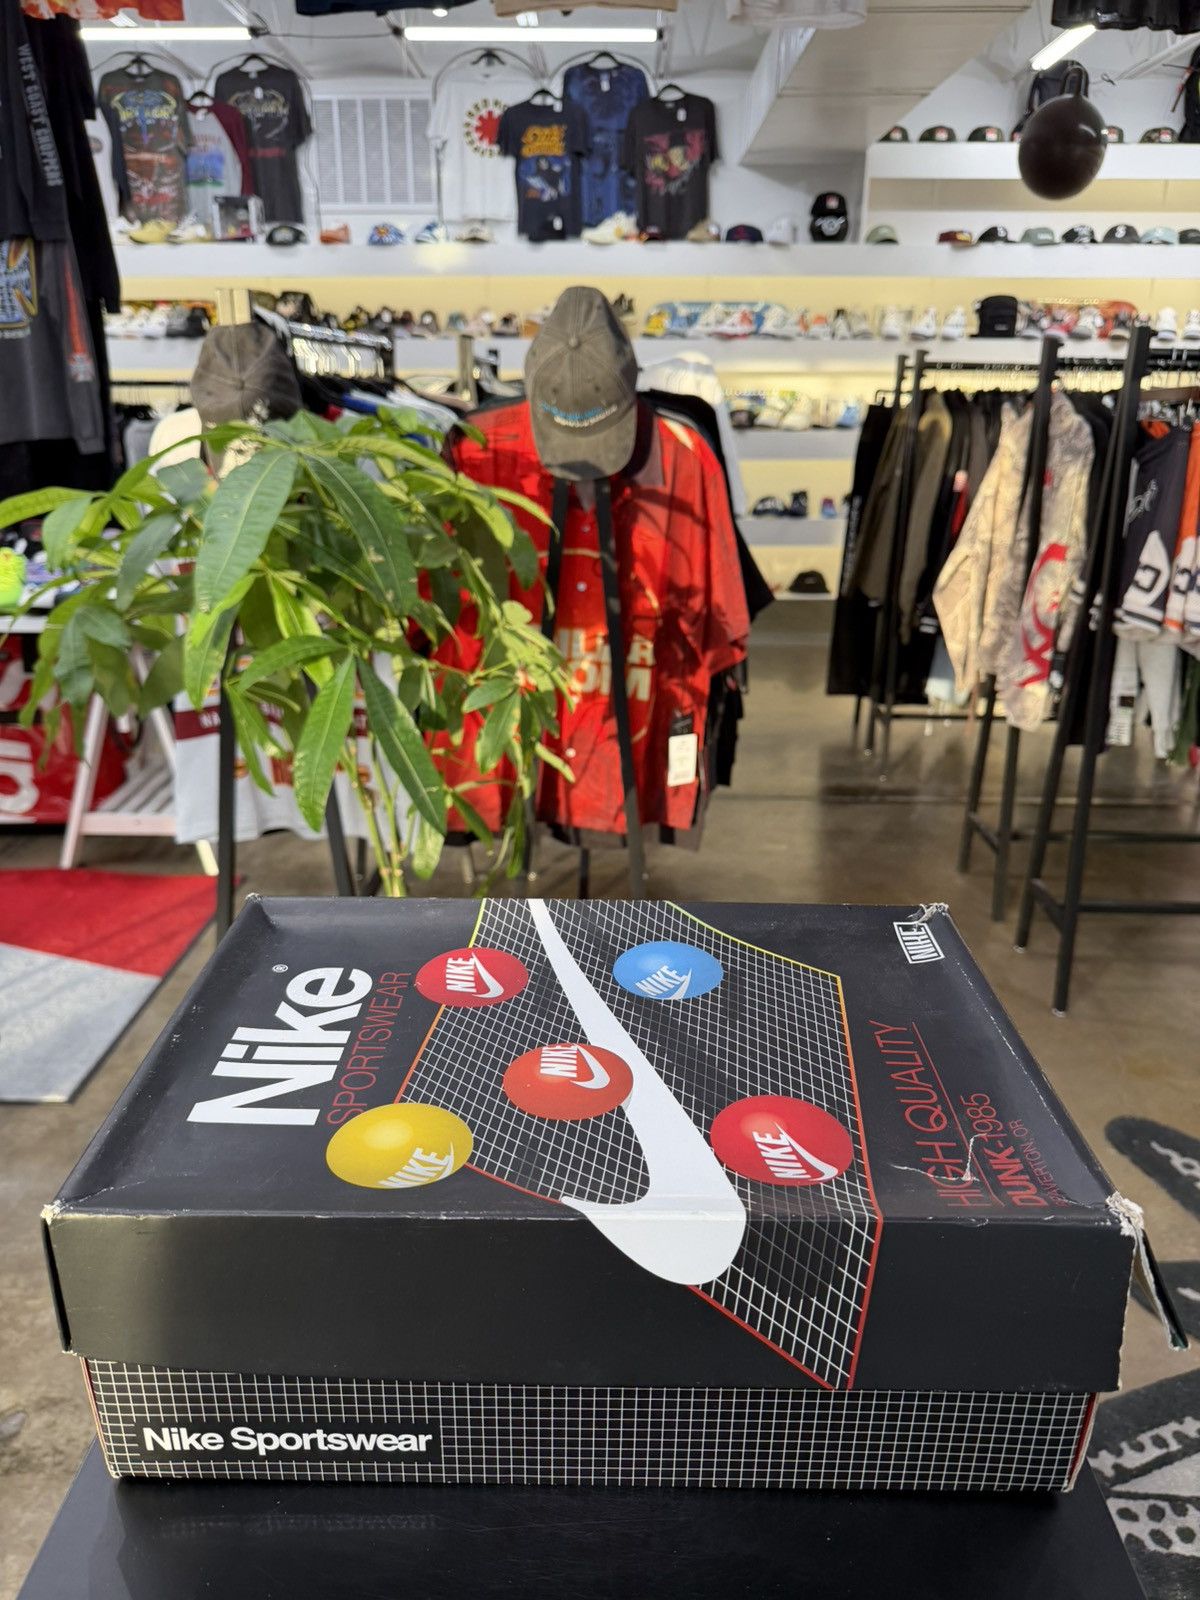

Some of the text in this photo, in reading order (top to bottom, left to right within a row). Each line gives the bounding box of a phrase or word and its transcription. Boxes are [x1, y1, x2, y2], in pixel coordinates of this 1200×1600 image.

[18, 43, 37, 80] WEST
[26, 84, 48, 123] COAST
[445, 955, 477, 993] NIKE
[635, 965, 688, 996] NIKE
[326, 970, 412, 1126] SPORTSWEAR
[540, 1045, 578, 1078] NIKE
[868, 1019, 992, 1207] HIGH QUALITY
[378, 1147, 451, 1188] NIKE
[752, 1131, 811, 1179] NIKE
[142, 1426, 432, 1456] Nike Sportswear
